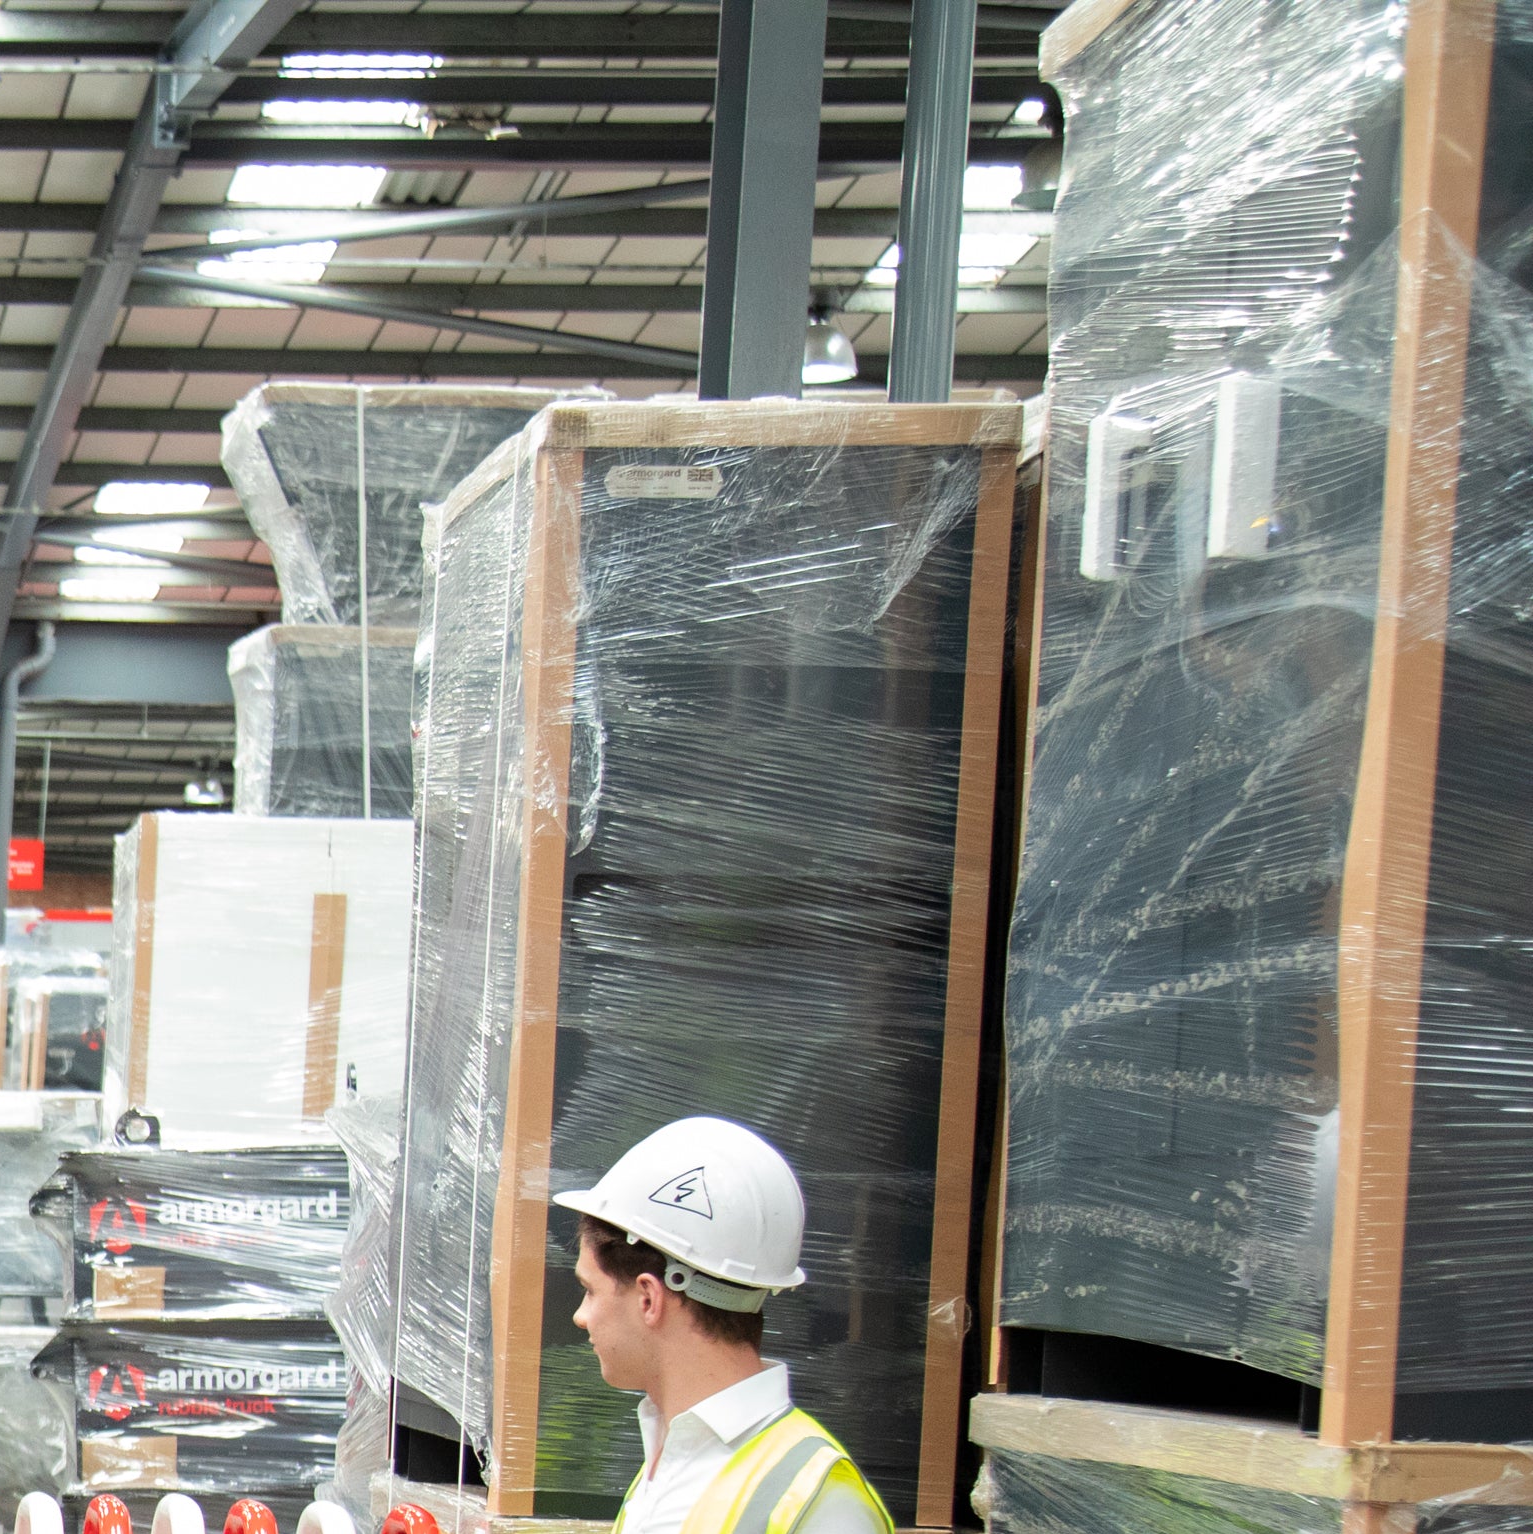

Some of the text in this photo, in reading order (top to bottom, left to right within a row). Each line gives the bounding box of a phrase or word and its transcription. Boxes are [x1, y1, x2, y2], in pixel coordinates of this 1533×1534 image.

[156, 1189, 338, 1228] armorgard
[157, 1358, 337, 1395] armorgard
[224, 1397, 277, 1415] truck
